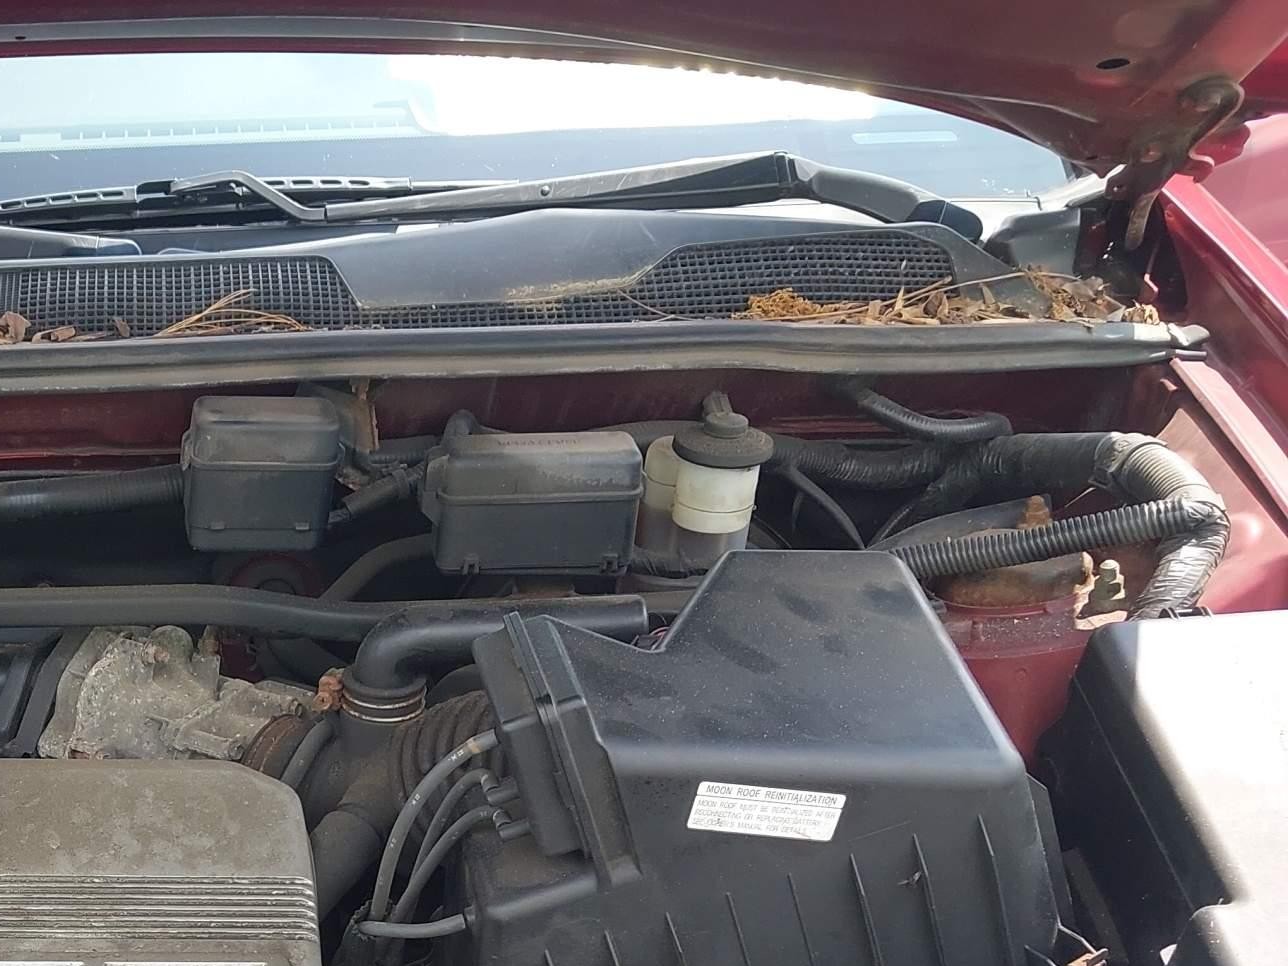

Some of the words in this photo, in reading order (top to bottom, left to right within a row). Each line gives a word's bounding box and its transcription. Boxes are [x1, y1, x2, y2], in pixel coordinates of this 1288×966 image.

[706, 784, 733, 795] MOON
[737, 787, 761, 797] ROOF
[765, 791, 838, 806] REINITIALIZATION
[697, 799, 717, 807] MOON
[719, 801, 736, 809] ROOF
